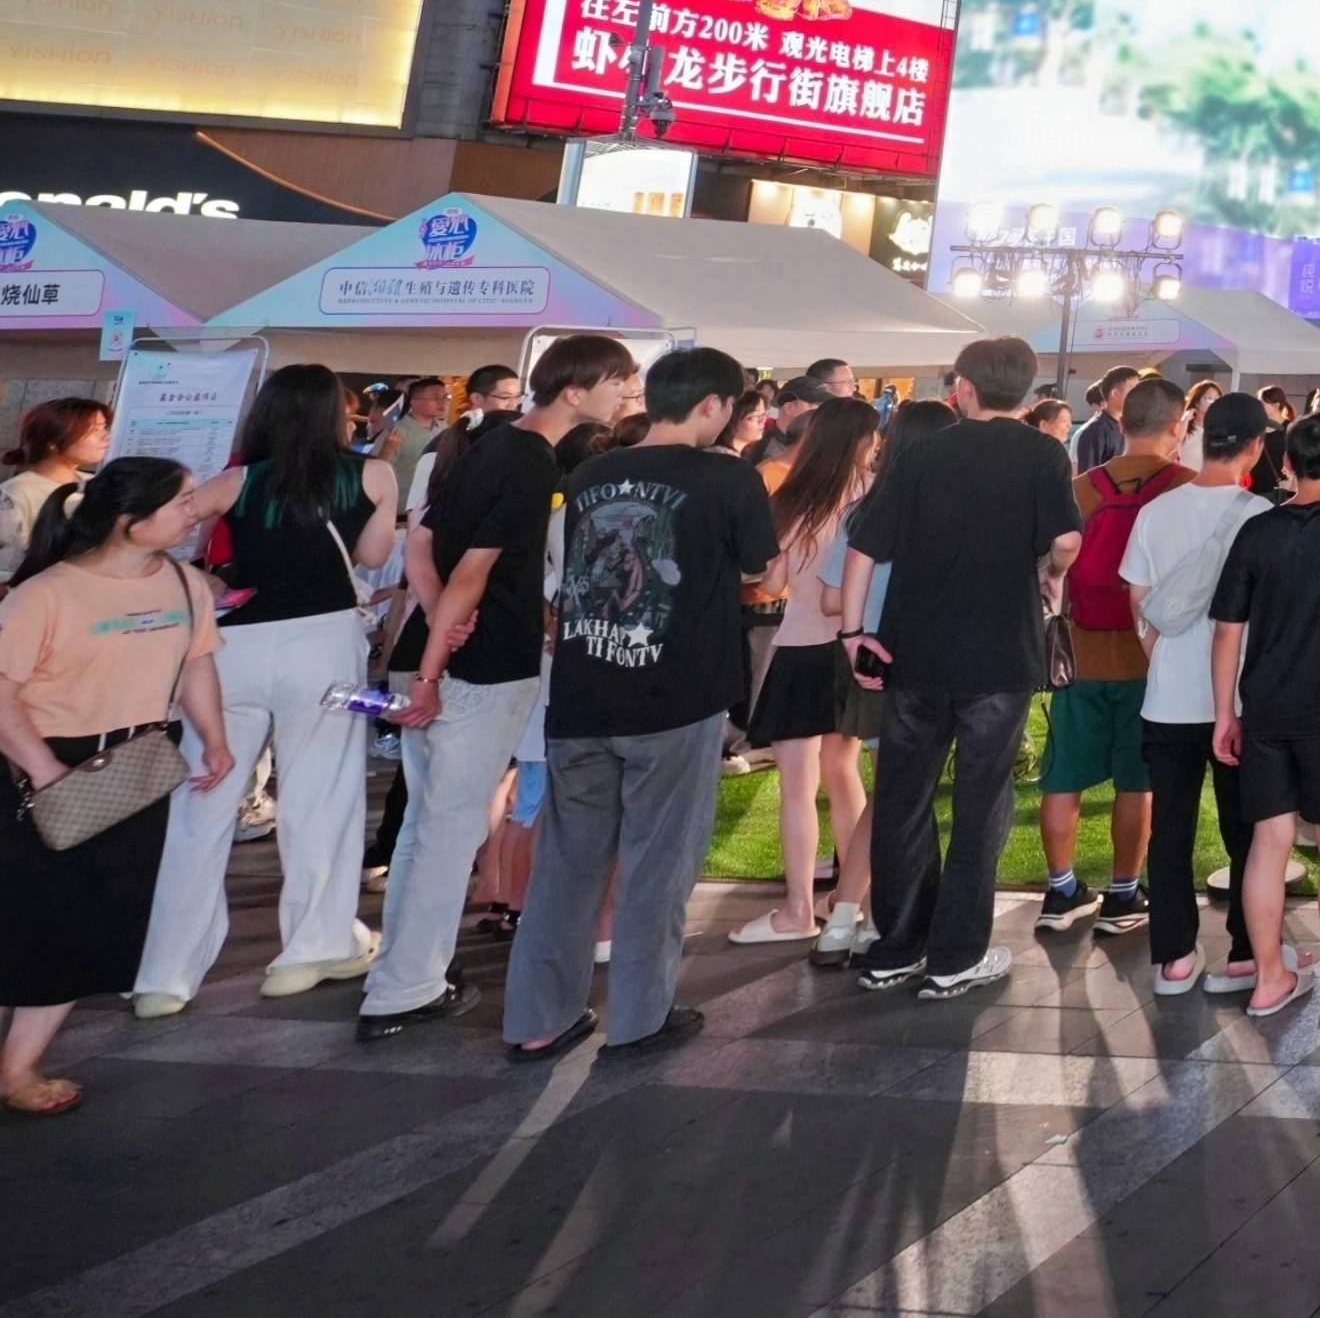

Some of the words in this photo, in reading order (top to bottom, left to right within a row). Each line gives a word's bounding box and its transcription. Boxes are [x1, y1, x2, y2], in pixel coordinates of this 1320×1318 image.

[573, 27, 927, 128] 虾龙步行街旗舰店
[779, 30, 930, 83] 观光电梯上4楼
[1, 284, 60, 306] 烧仙草
